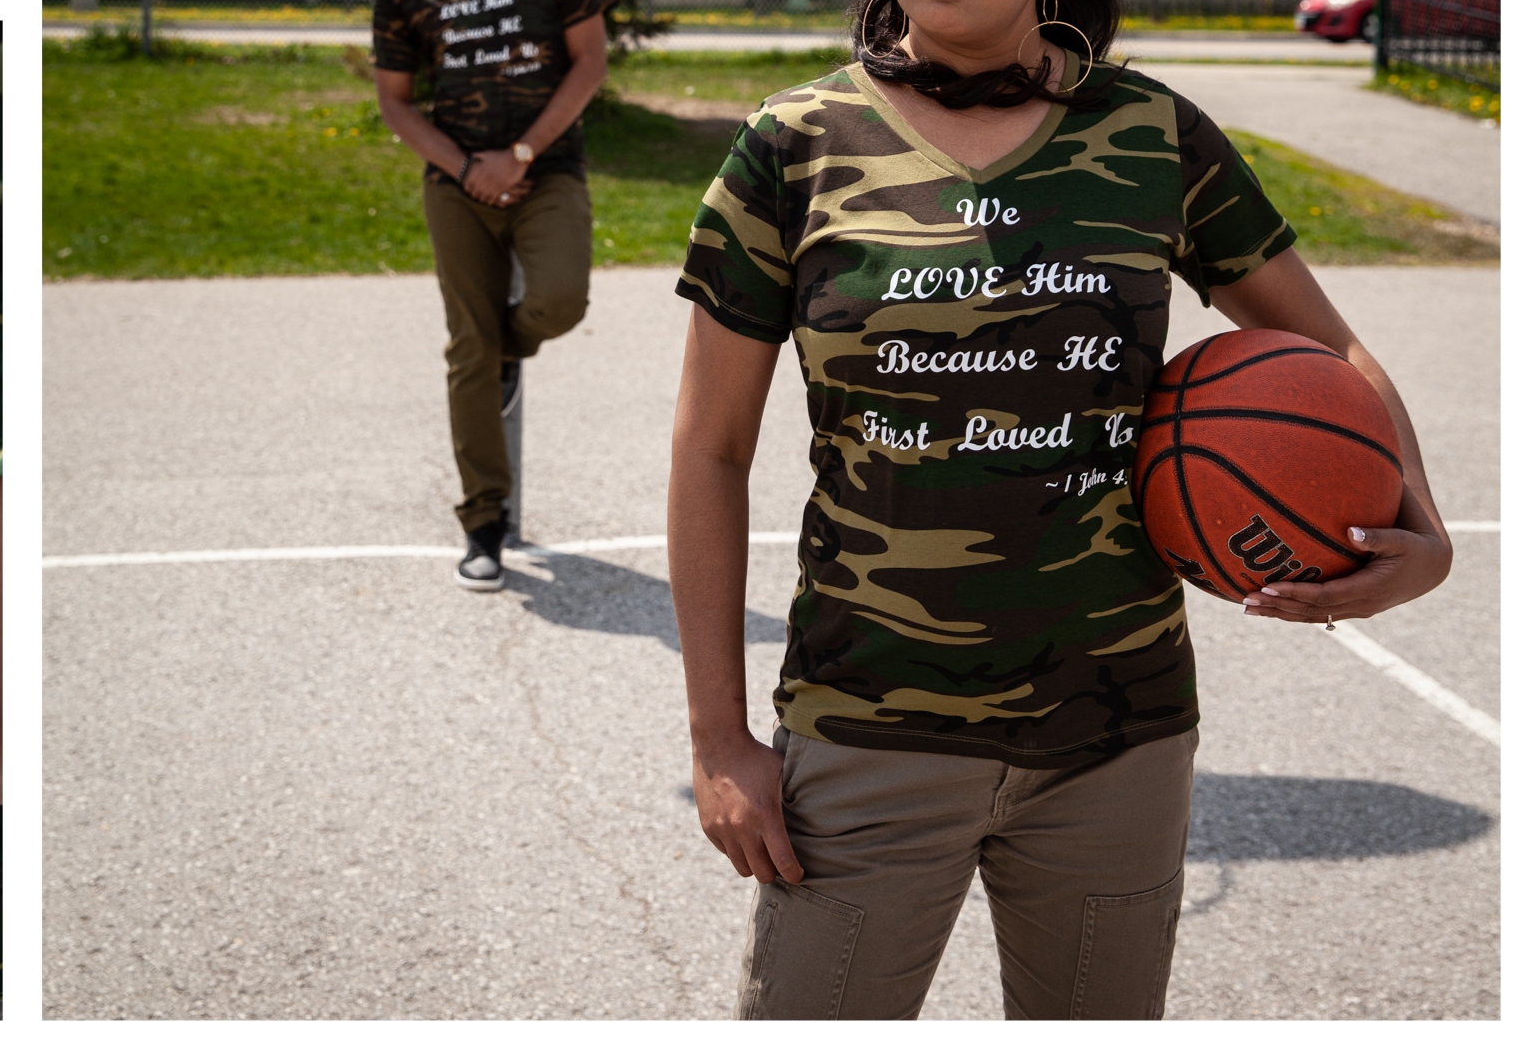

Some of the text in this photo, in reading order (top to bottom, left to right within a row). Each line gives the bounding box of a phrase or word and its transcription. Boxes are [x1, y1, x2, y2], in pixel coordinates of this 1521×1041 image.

[956, 197, 1021, 226] We
[881, 262, 1111, 301] LOVE Him
[876, 335, 1123, 374] Because HE
[862, 410, 931, 451] First
[957, 412, 1073, 451] Loved
[1078, 467, 1107, 496] John
